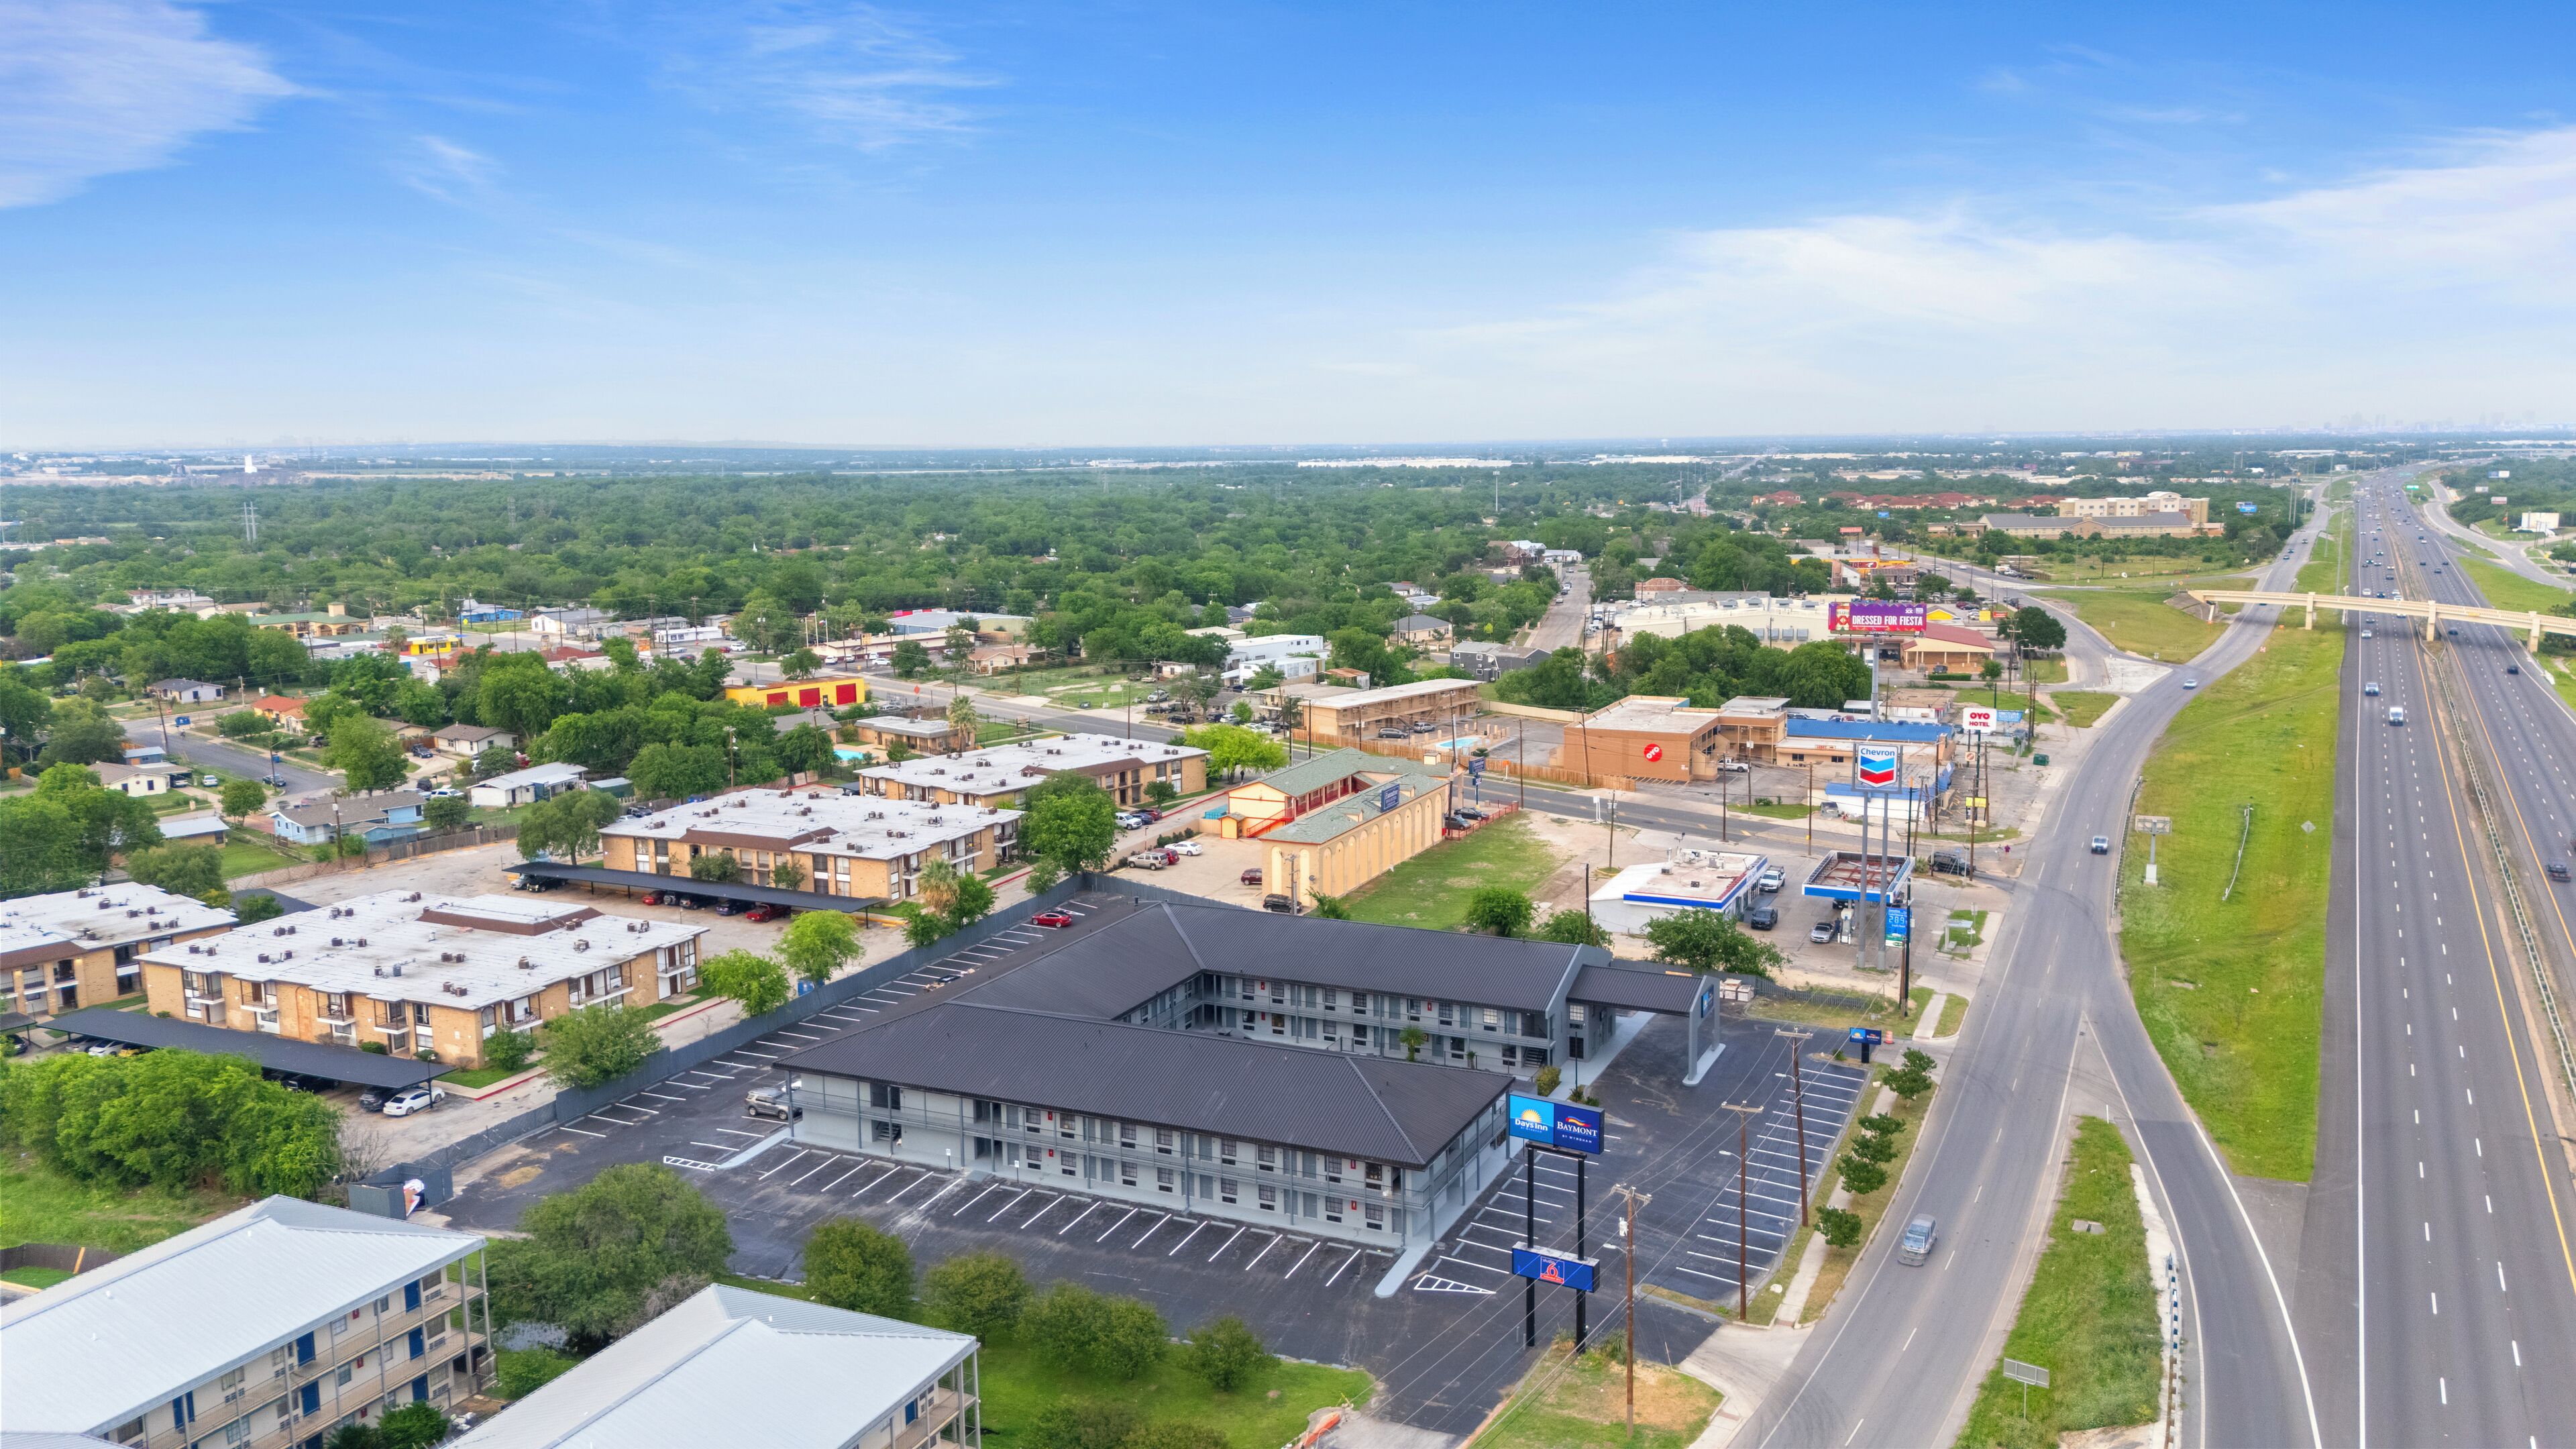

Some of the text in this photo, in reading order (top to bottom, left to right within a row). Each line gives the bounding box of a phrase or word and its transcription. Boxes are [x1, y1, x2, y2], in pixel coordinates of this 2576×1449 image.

[1852, 615, 1923, 626] DRESSED FOR FIESTA
[1970, 712, 1990, 720] OYO
[1646, 746, 1660, 759] OYO
[1860, 748, 1895, 756] Chevron
[1515, 1118, 1548, 1131] Days Inn
[1546, 1263, 1558, 1277] 6
